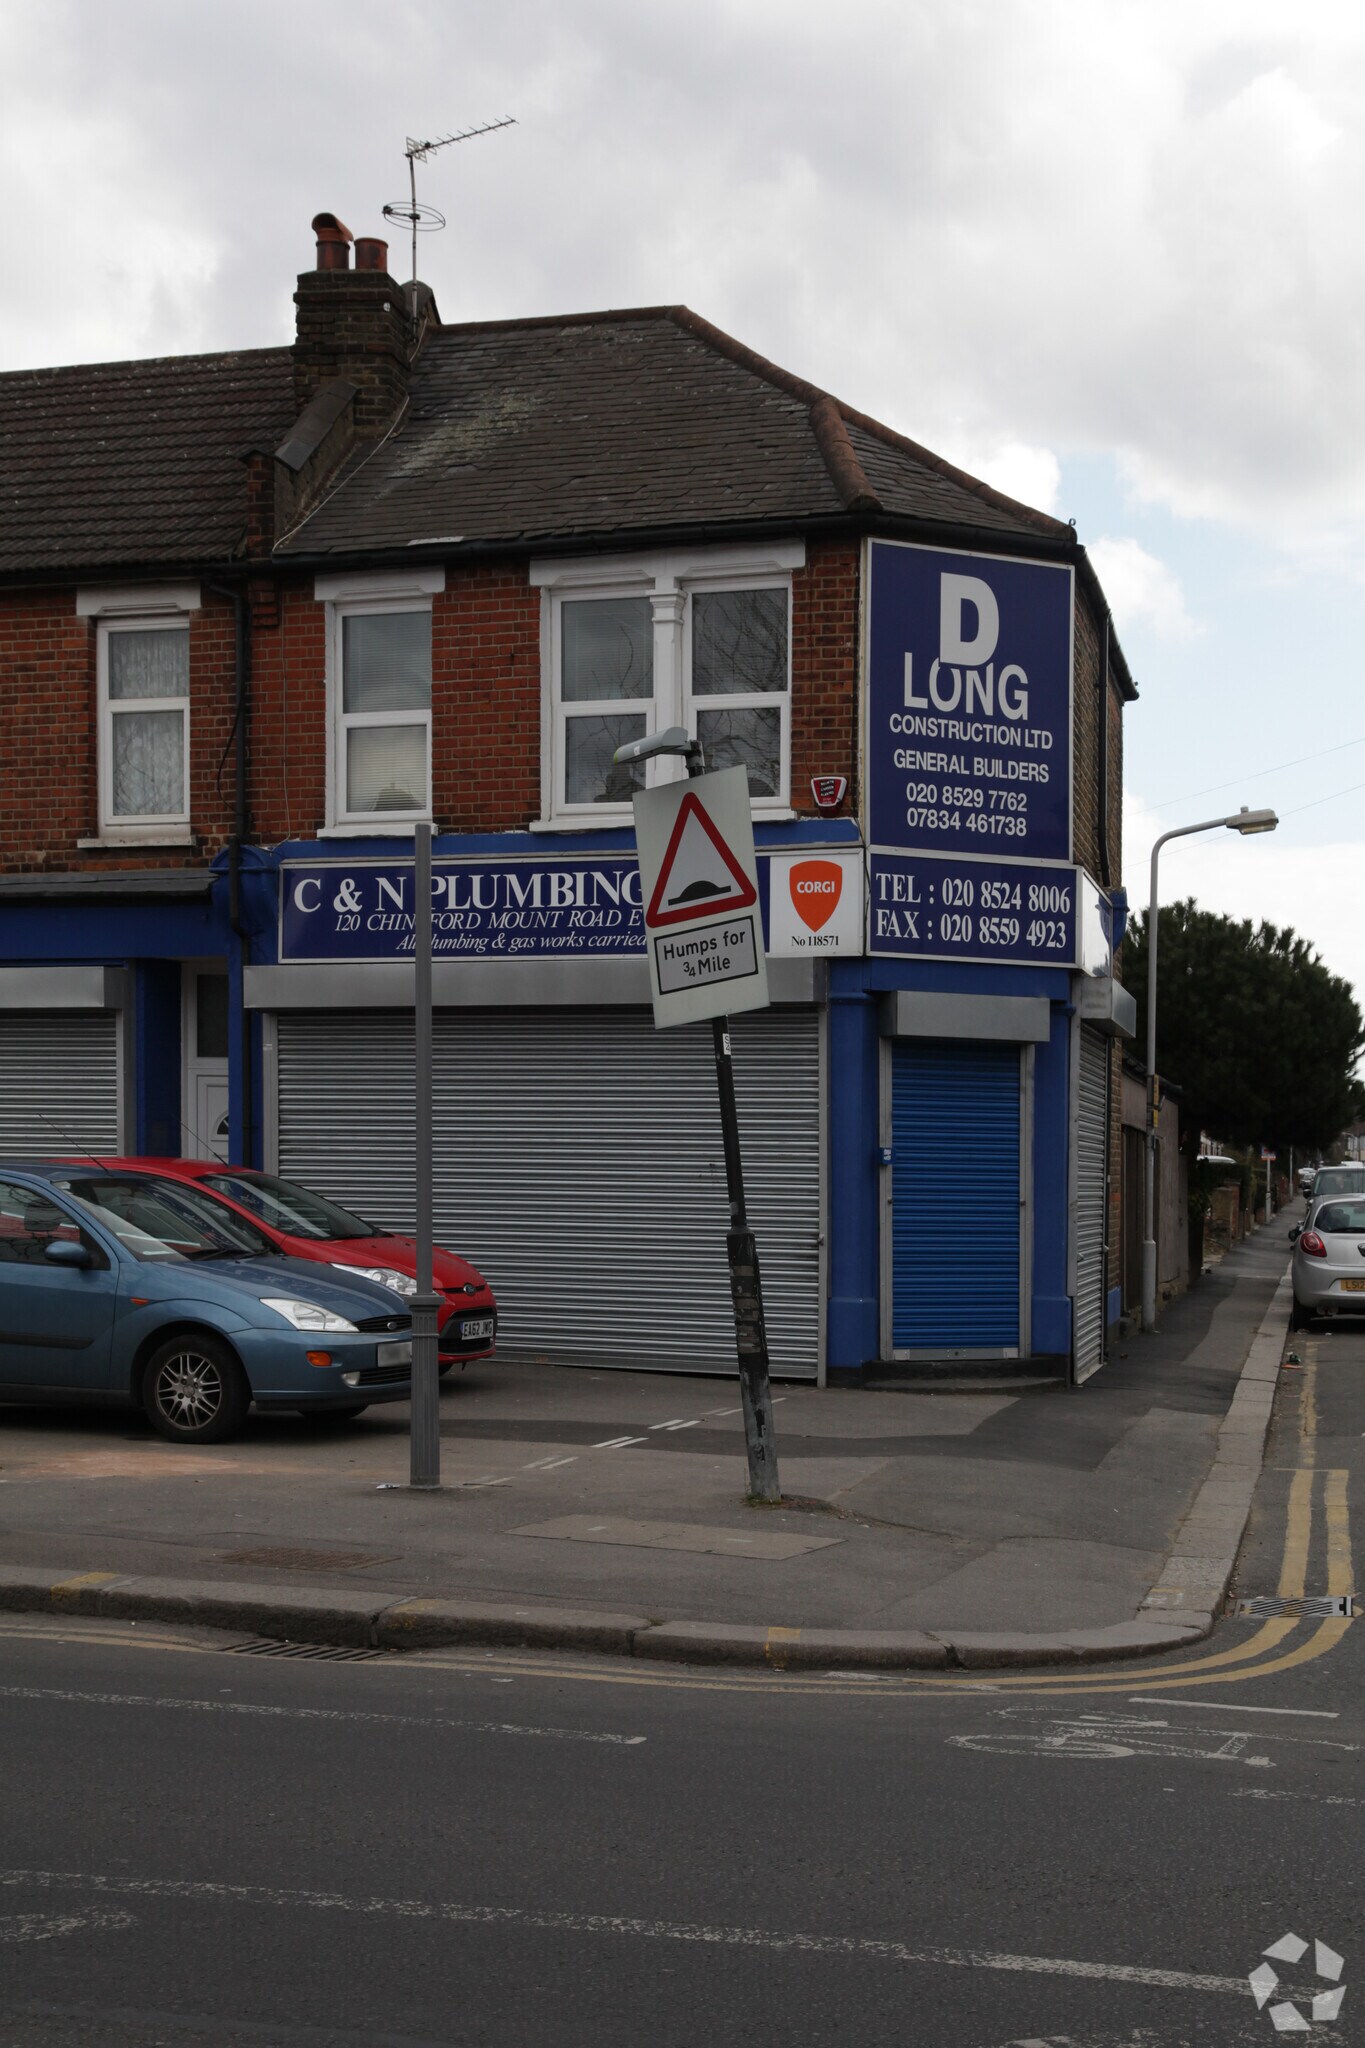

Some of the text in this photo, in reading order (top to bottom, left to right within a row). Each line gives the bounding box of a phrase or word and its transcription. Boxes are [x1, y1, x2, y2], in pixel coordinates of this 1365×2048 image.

[940, 573, 999, 666] D
[904, 652, 1028, 720] LONG
[890, 714, 1052, 749] CONSTRUCTION LTD
[894, 749, 1049, 783] GENERAL BUILDERS
[907, 783, 1027, 811] 020 8529 7762
[907, 808, 1027, 836] 07834 461738
[294, 878, 321, 912] C
[333, 878, 362, 912] &
[375, 877, 407, 911] N
[797, 881, 835, 894] CORGI
[942, 878, 974, 907] 020
[981, 882, 1021, 910] 8524
[1029, 884, 1070, 914] 8006
[335, 914, 360, 931] 120
[367, 912, 481, 931] CHINFORD
[488, 911, 564, 928] MOUNT
[568, 910, 622, 928] ROAD
[940, 914, 972, 942] 020
[979, 917, 1019, 945] 8559
[1026, 920, 1066, 948] 4923
[431, 934, 489, 952] lumbing
[492, 933, 507, 948] &
[508, 936, 536, 952] gas
[540, 933, 583, 948] works
[664, 931, 746, 960] Humps for
[792, 936, 839, 946] No 118571
[698, 957, 730, 974] Mile
